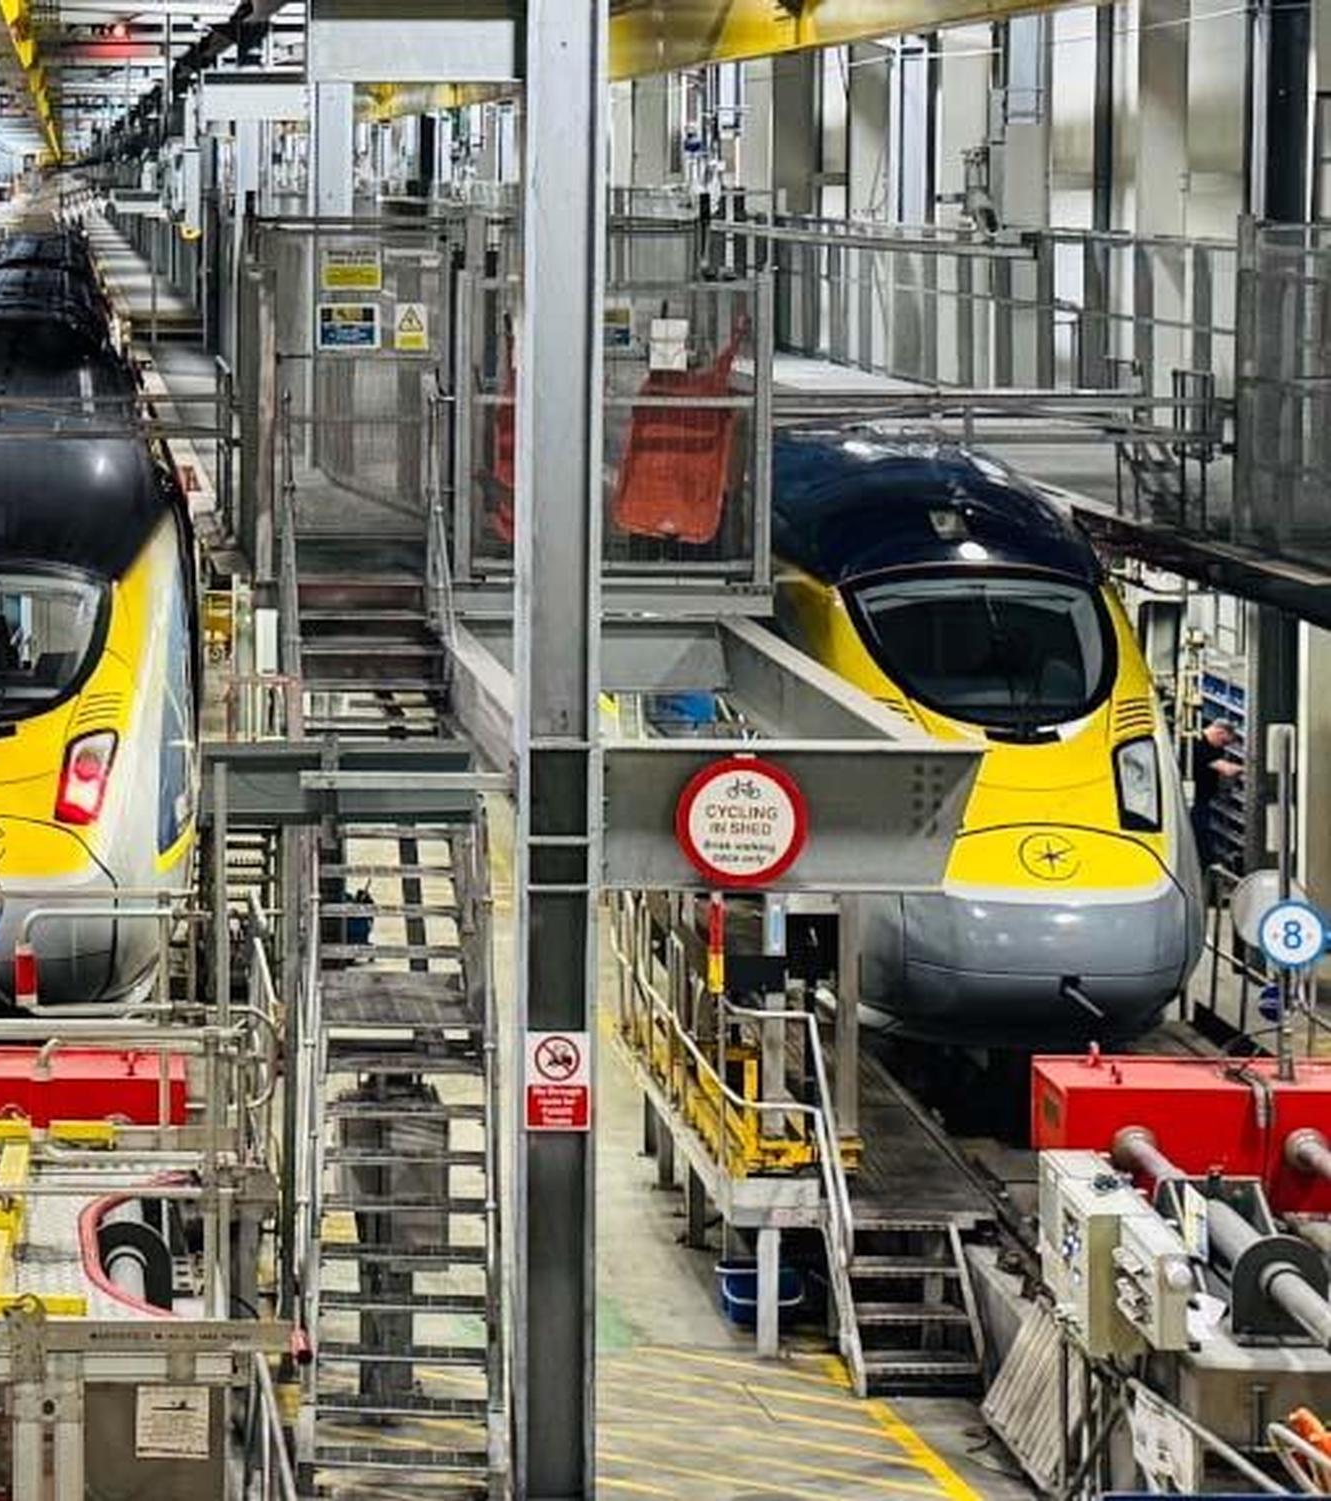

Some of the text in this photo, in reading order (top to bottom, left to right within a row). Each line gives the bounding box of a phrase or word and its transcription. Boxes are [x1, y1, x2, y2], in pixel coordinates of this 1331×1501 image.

[705, 804, 778, 819] CYCLING
[709, 822, 771, 835] IN SHED
[1283, 920, 1303, 949] 8
